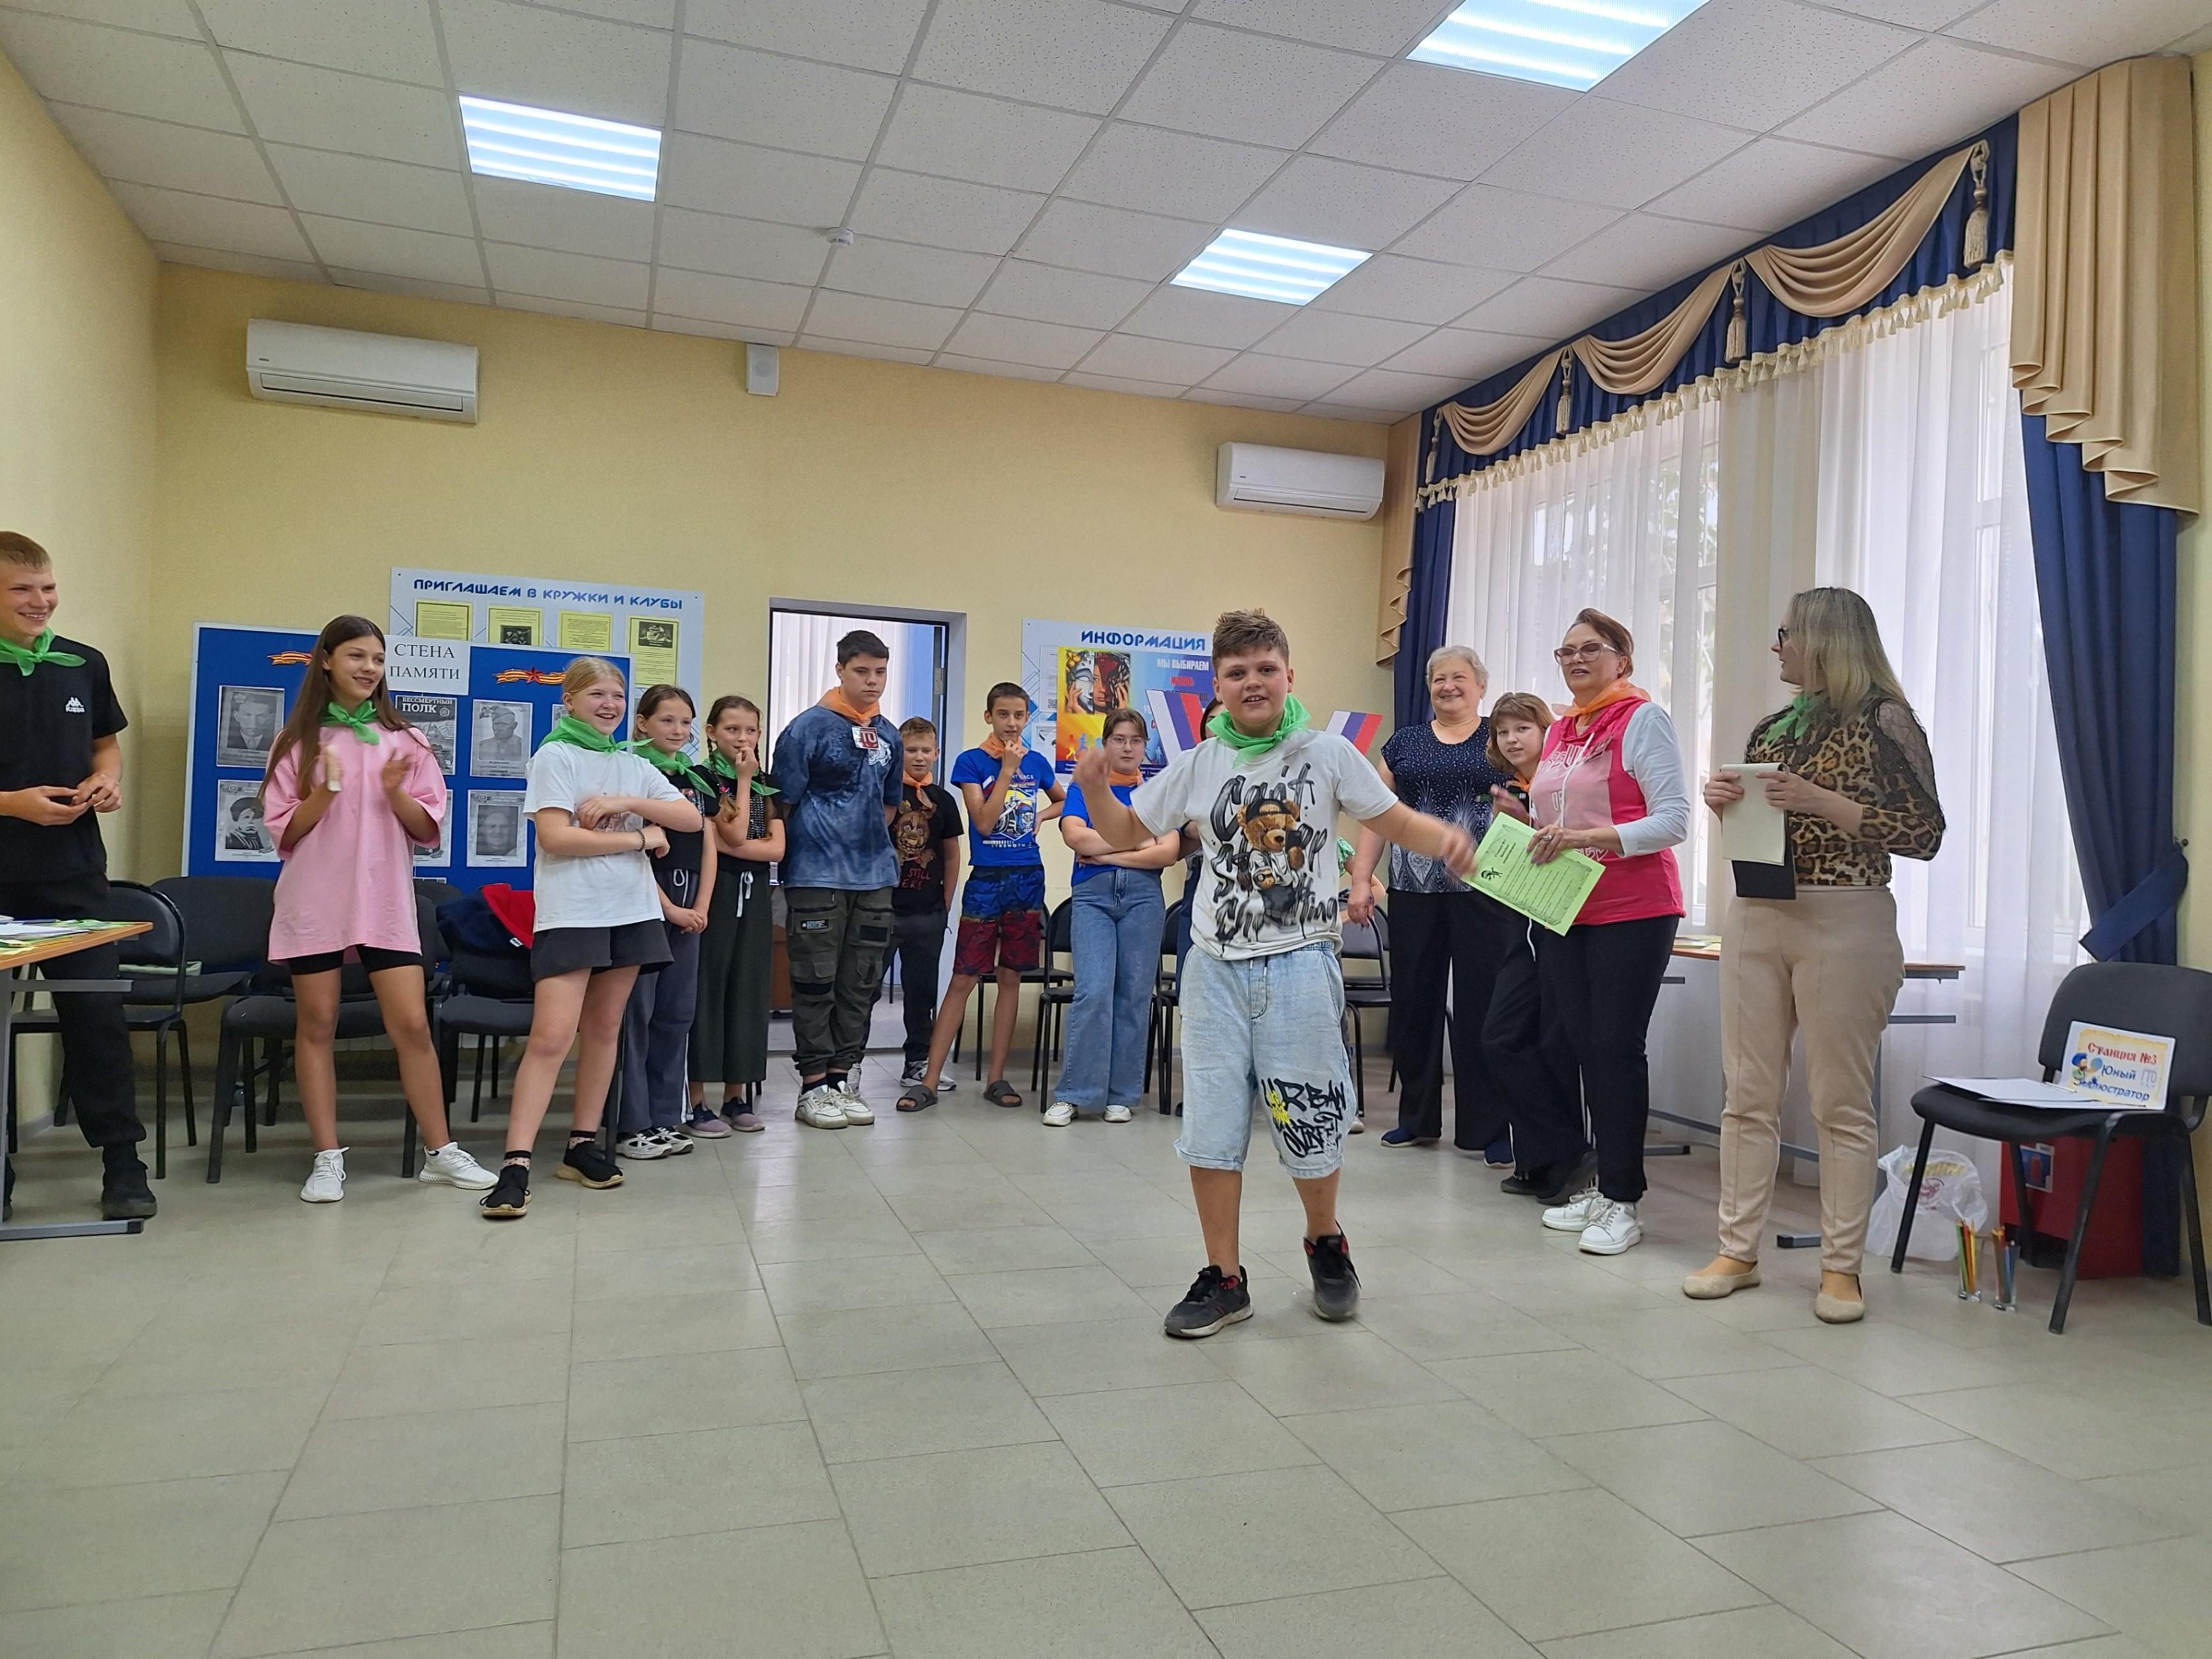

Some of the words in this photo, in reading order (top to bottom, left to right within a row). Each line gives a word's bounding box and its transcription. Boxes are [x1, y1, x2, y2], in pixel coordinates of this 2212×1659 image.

[414, 579, 521, 597] ПРИГЛАШАЕМ
[527, 588, 537, 597] В
[543, 589, 608, 604] КРУЖКИ
[614, 594, 624, 605] И
[629, 596, 682, 610] КЛУБЫ
[1081, 630, 1206, 651] ИНФОРМАЦИЯ
[394, 643, 455, 659] СТЕНА
[1156, 657, 1170, 668] МЫ
[1171, 659, 1210, 671] ВЫБИРАЕМ
[389, 666, 460, 680] ПАМЯТИ
[402, 703, 437, 713] ПОЛК
[907, 868, 931, 880] STILL
[2088, 1042, 2137, 1062] Станция
[2102, 1063, 2137, 1081] Юный
[1261, 1077, 1346, 1112] URBAN
